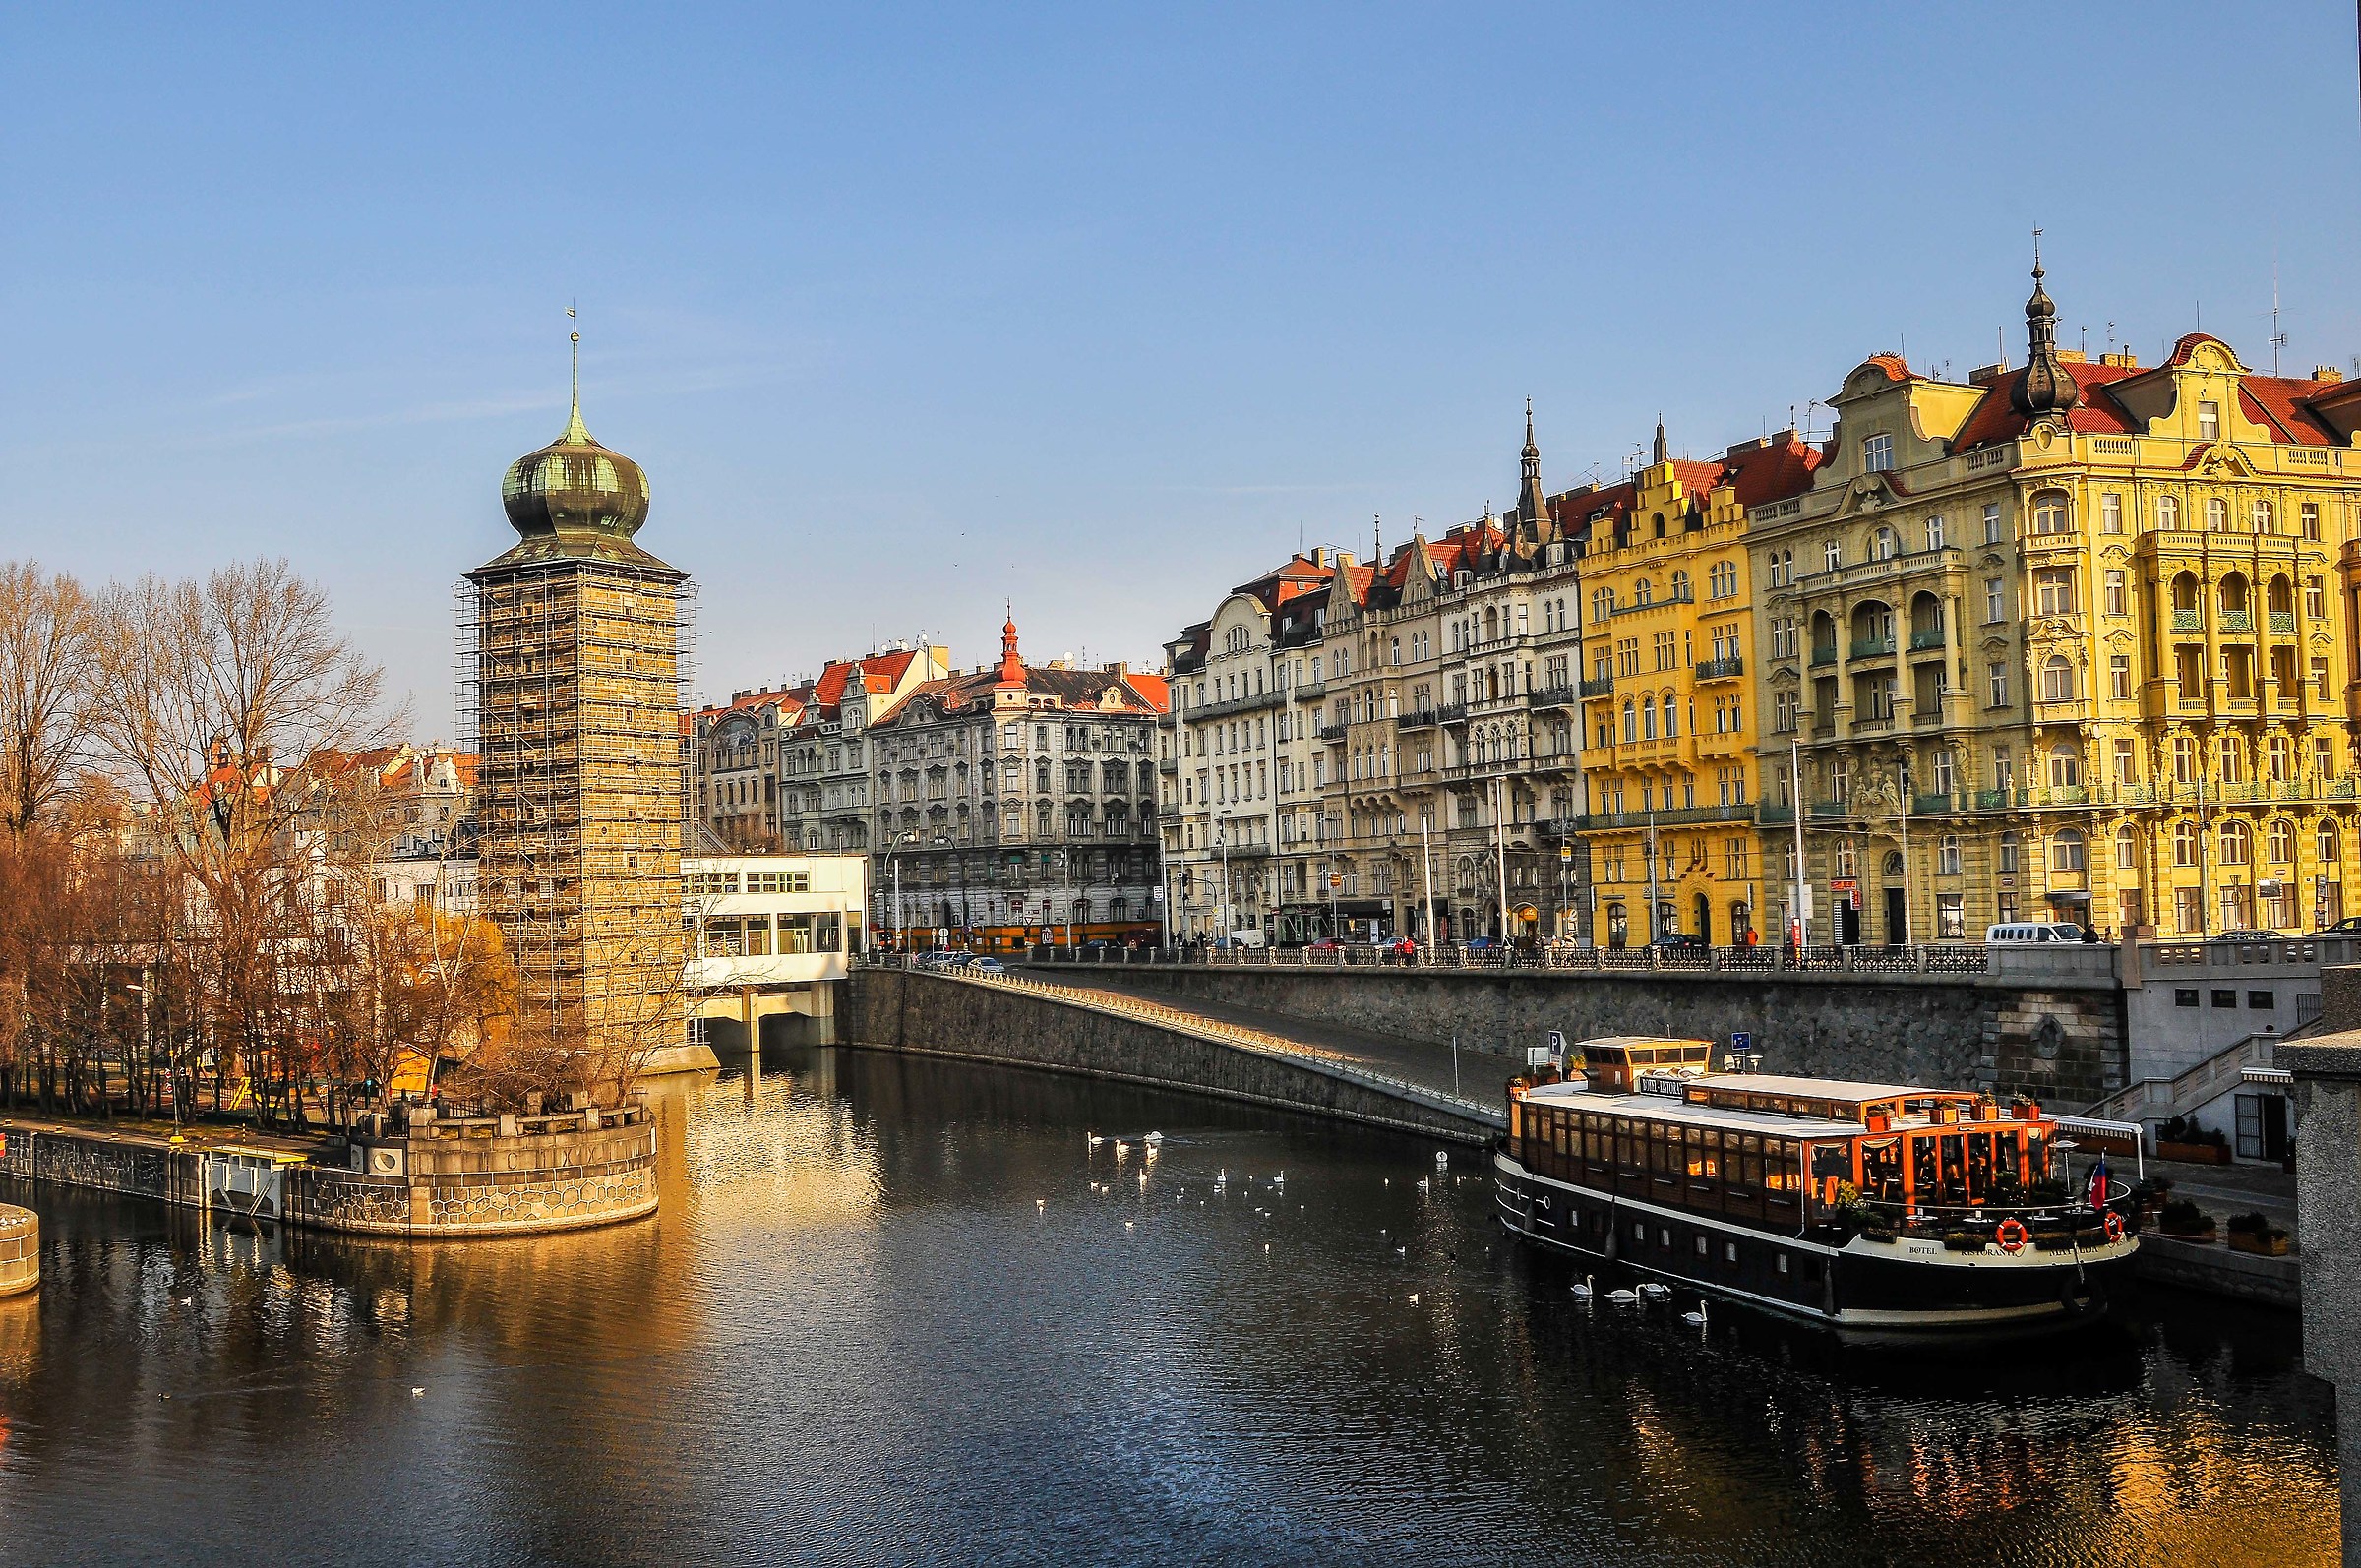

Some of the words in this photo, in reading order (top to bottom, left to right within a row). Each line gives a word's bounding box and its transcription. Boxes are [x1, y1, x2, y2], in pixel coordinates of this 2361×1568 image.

[1551, 1035, 1558, 1052] P
[1908, 1246, 1937, 1255] BOTEL
[2049, 1246, 2099, 1257] MATLDA
